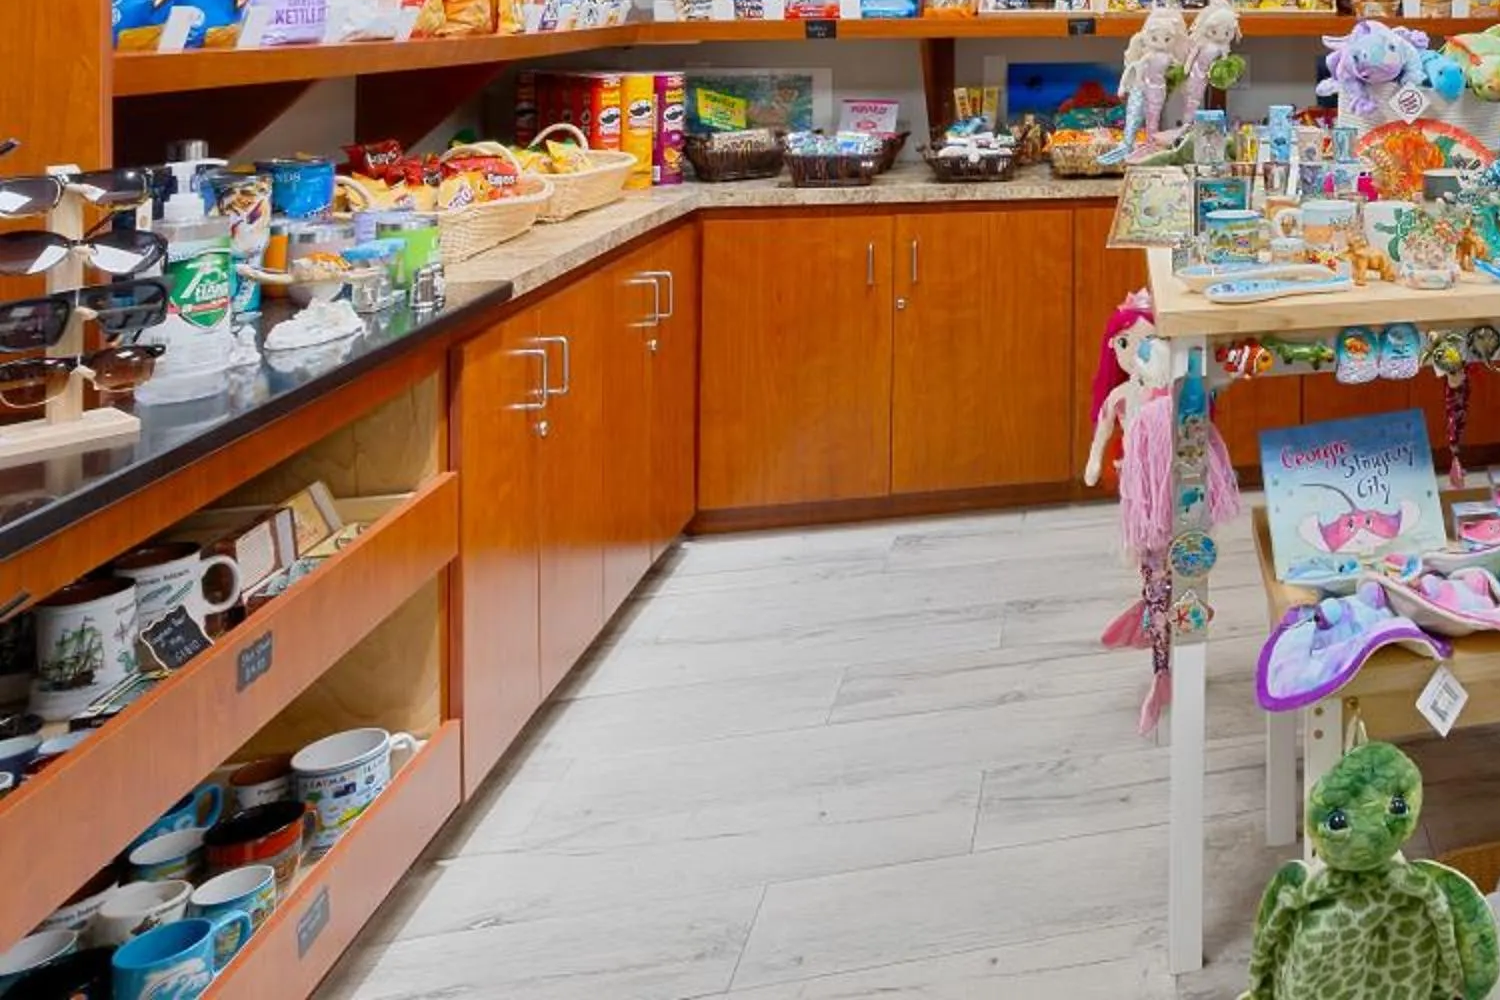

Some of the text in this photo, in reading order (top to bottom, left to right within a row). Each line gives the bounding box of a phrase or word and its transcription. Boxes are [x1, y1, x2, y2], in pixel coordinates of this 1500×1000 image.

[1280, 438, 1350, 470] George
[1339, 442, 1415, 479] Stingray
[1356, 471, 1392, 505] City
